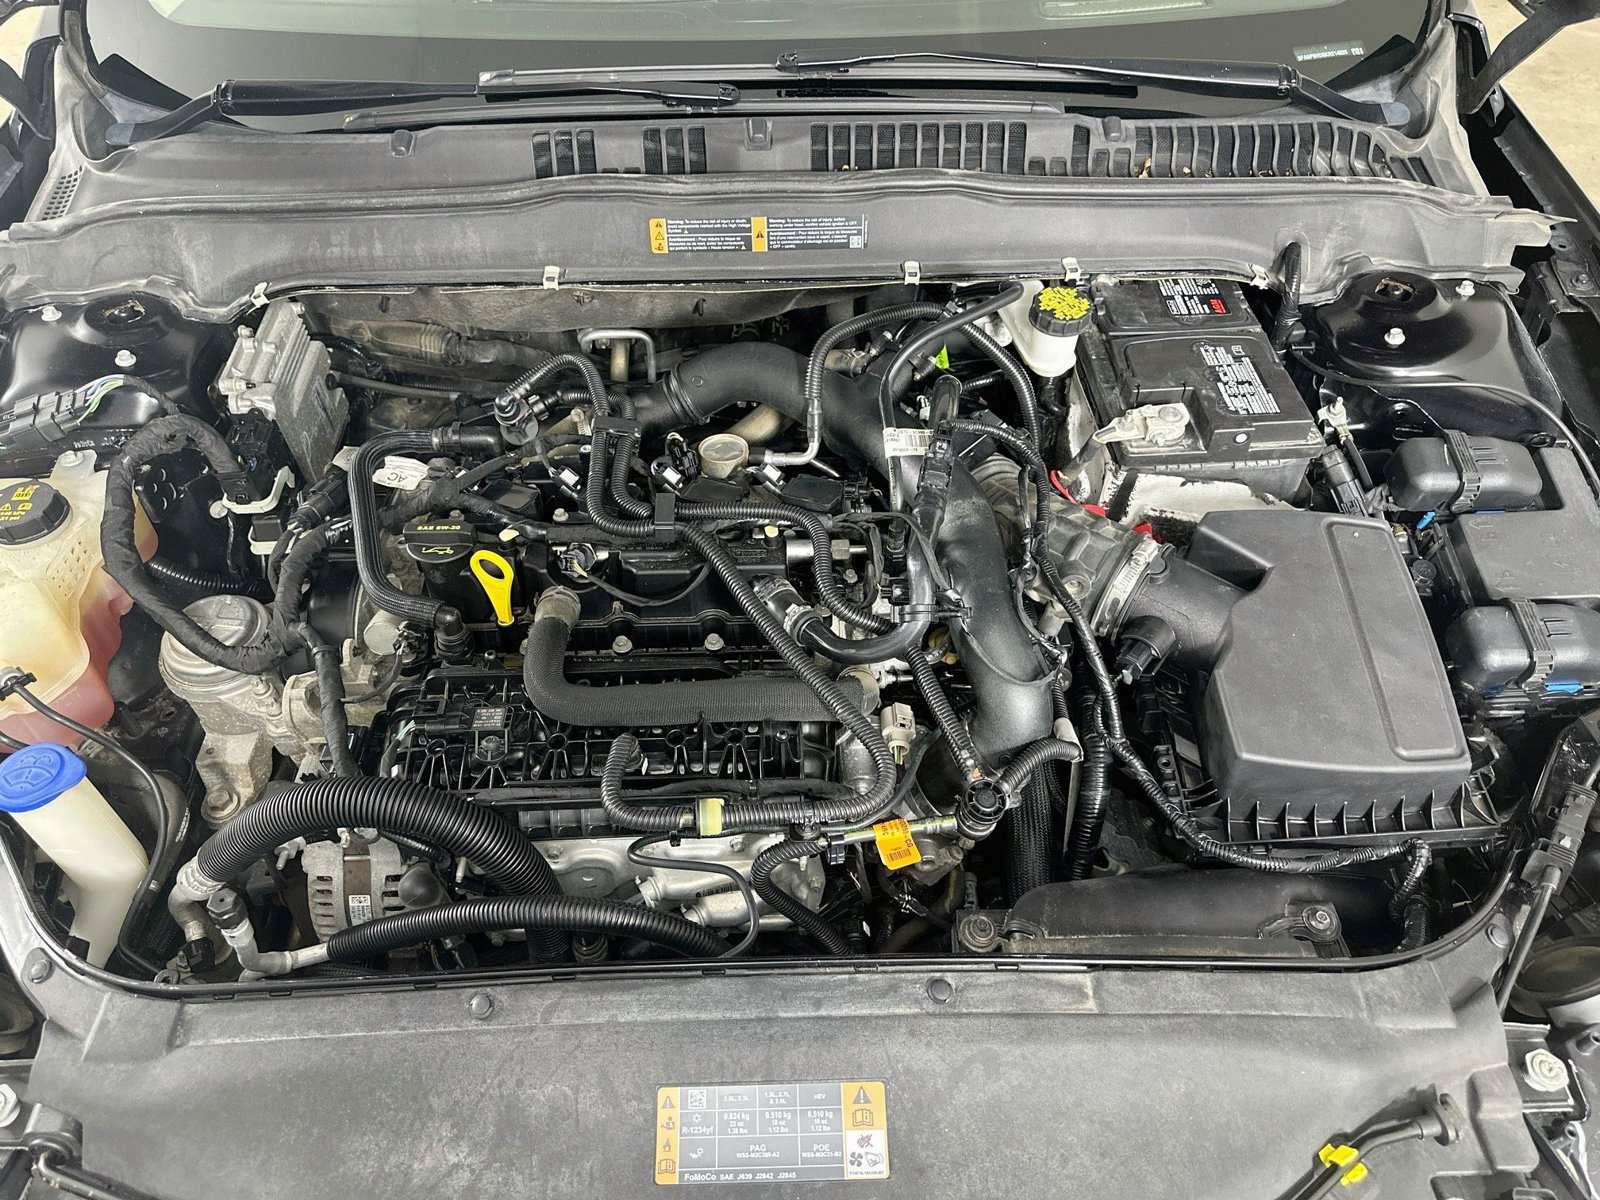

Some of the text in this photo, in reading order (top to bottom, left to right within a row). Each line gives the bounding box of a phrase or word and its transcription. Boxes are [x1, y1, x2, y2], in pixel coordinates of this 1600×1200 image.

[741, 1112, 750, 1121] kg
[783, 1111, 792, 1120] kg
[825, 1110, 833, 1119] kg
[681, 1125, 714, 1135] R-1234yf
[750, 1144, 767, 1152] PAG
[813, 1144, 831, 1152] POE
[684, 1173, 716, 1181] FoMoCo
